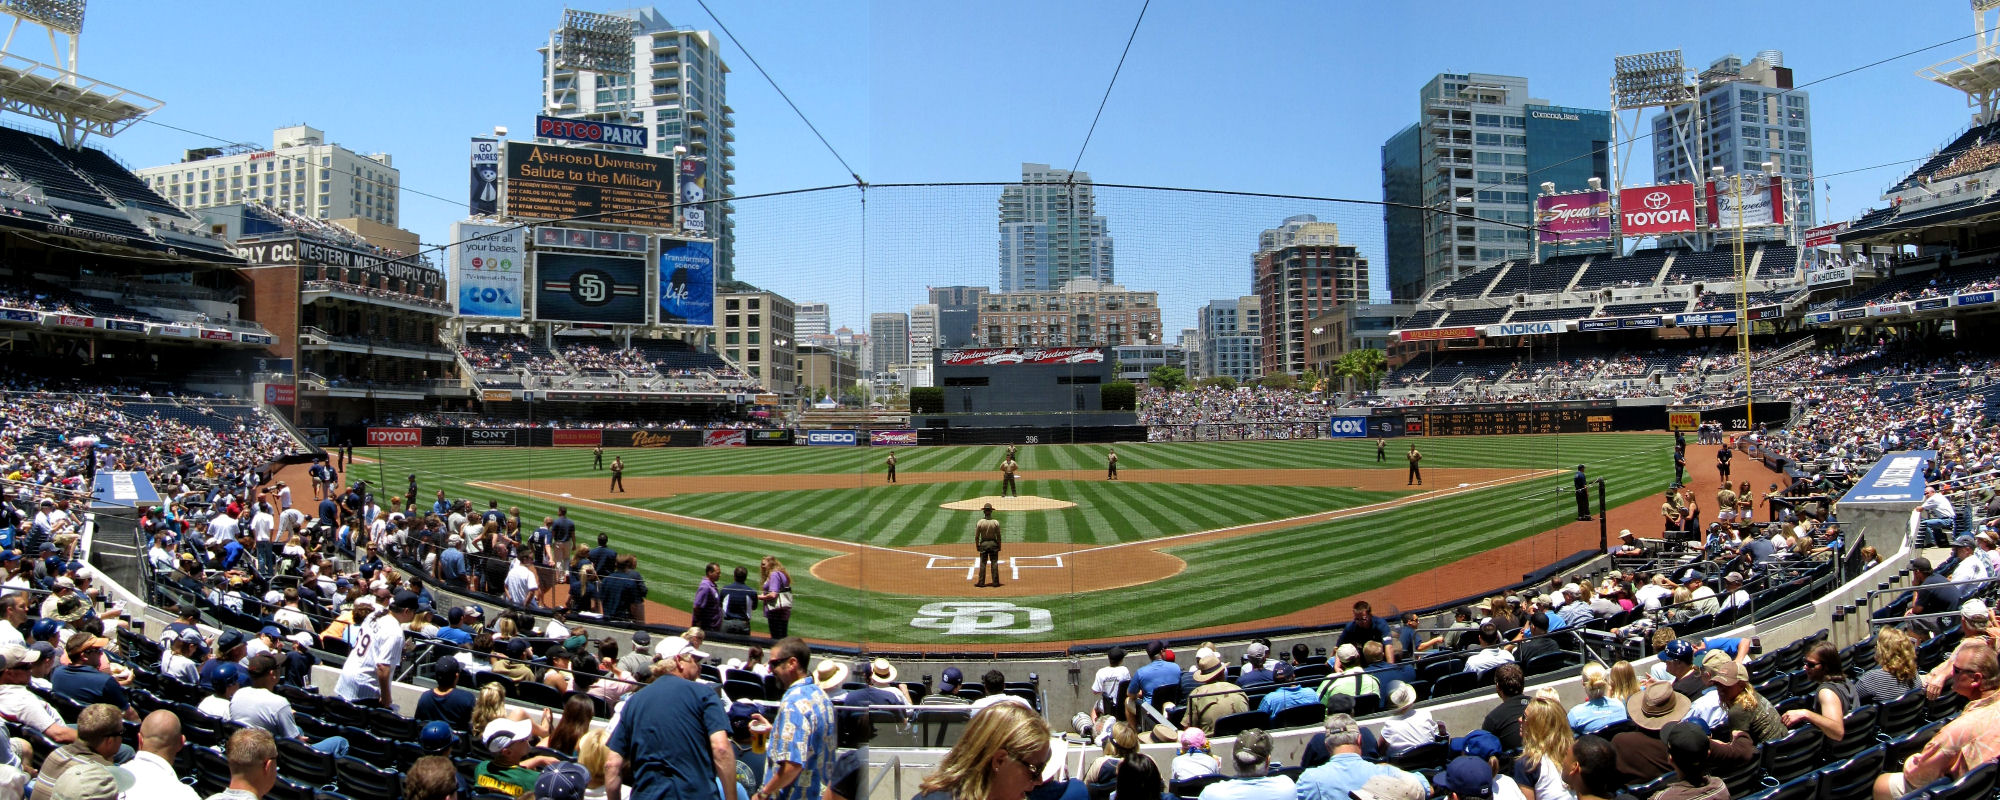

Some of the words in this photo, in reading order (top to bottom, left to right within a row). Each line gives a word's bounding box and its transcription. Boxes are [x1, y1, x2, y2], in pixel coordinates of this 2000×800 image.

[541, 120, 602, 140] PETCO
[603, 126, 644, 146] PARK
[479, 143, 492, 152] GO
[474, 153, 498, 162] PADRES
[528, 146, 592, 166] ASHFORD
[594, 154, 657, 172] UNIVERSITY
[521, 165, 565, 180] Salute
[569, 169, 583, 181] to
[587, 170, 609, 184] the
[613, 172, 661, 192] Military
[1543, 204, 1606, 225] Sycuan
[1625, 209, 1690, 226] TOYOTA
[687, 219, 704, 228] TACOS
[47, 224, 66, 236] SAN
[68, 227, 94, 240] DIEGO
[95, 231, 128, 245] PADRES
[472, 231, 500, 242] Cover
[502, 233, 513, 243] all
[272, 244, 297, 262] CO.
[466, 244, 487, 253] your
[300, 242, 350, 266] WESTERN
[354, 255, 385, 275] METAL
[388, 263, 422, 282] SUPPLY
[424, 270, 440, 286] CO.
[664, 253, 710, 266] Transforming
[675, 262, 700, 271] science
[469, 286, 513, 304] COX
[663, 282, 689, 307] life
[1683, 314, 1708, 323] ViaSat
[1410, 330, 1438, 338] WELLS
[1439, 328, 1468, 337] FARGO
[1501, 323, 1554, 335] NOKIA
[952, 348, 1007, 363] Budweiser
[1034, 347, 1089, 361] Budweiser
[1671, 414, 1692, 424] PETCO
[1732, 419, 1747, 429] 322
[1332, 420, 1363, 434] COX
[370, 431, 418, 442] TOYOTA
[471, 430, 508, 439] SONY
[631, 430, 671, 447] Padres
[810, 433, 854, 443] GEICO
[873, 431, 912, 443] Sycuan
[1025, 435, 1039, 444] 396
[1275, 431, 1290, 439] 400
[436, 436, 450, 446] 357
[794, 438, 806, 446] 401
